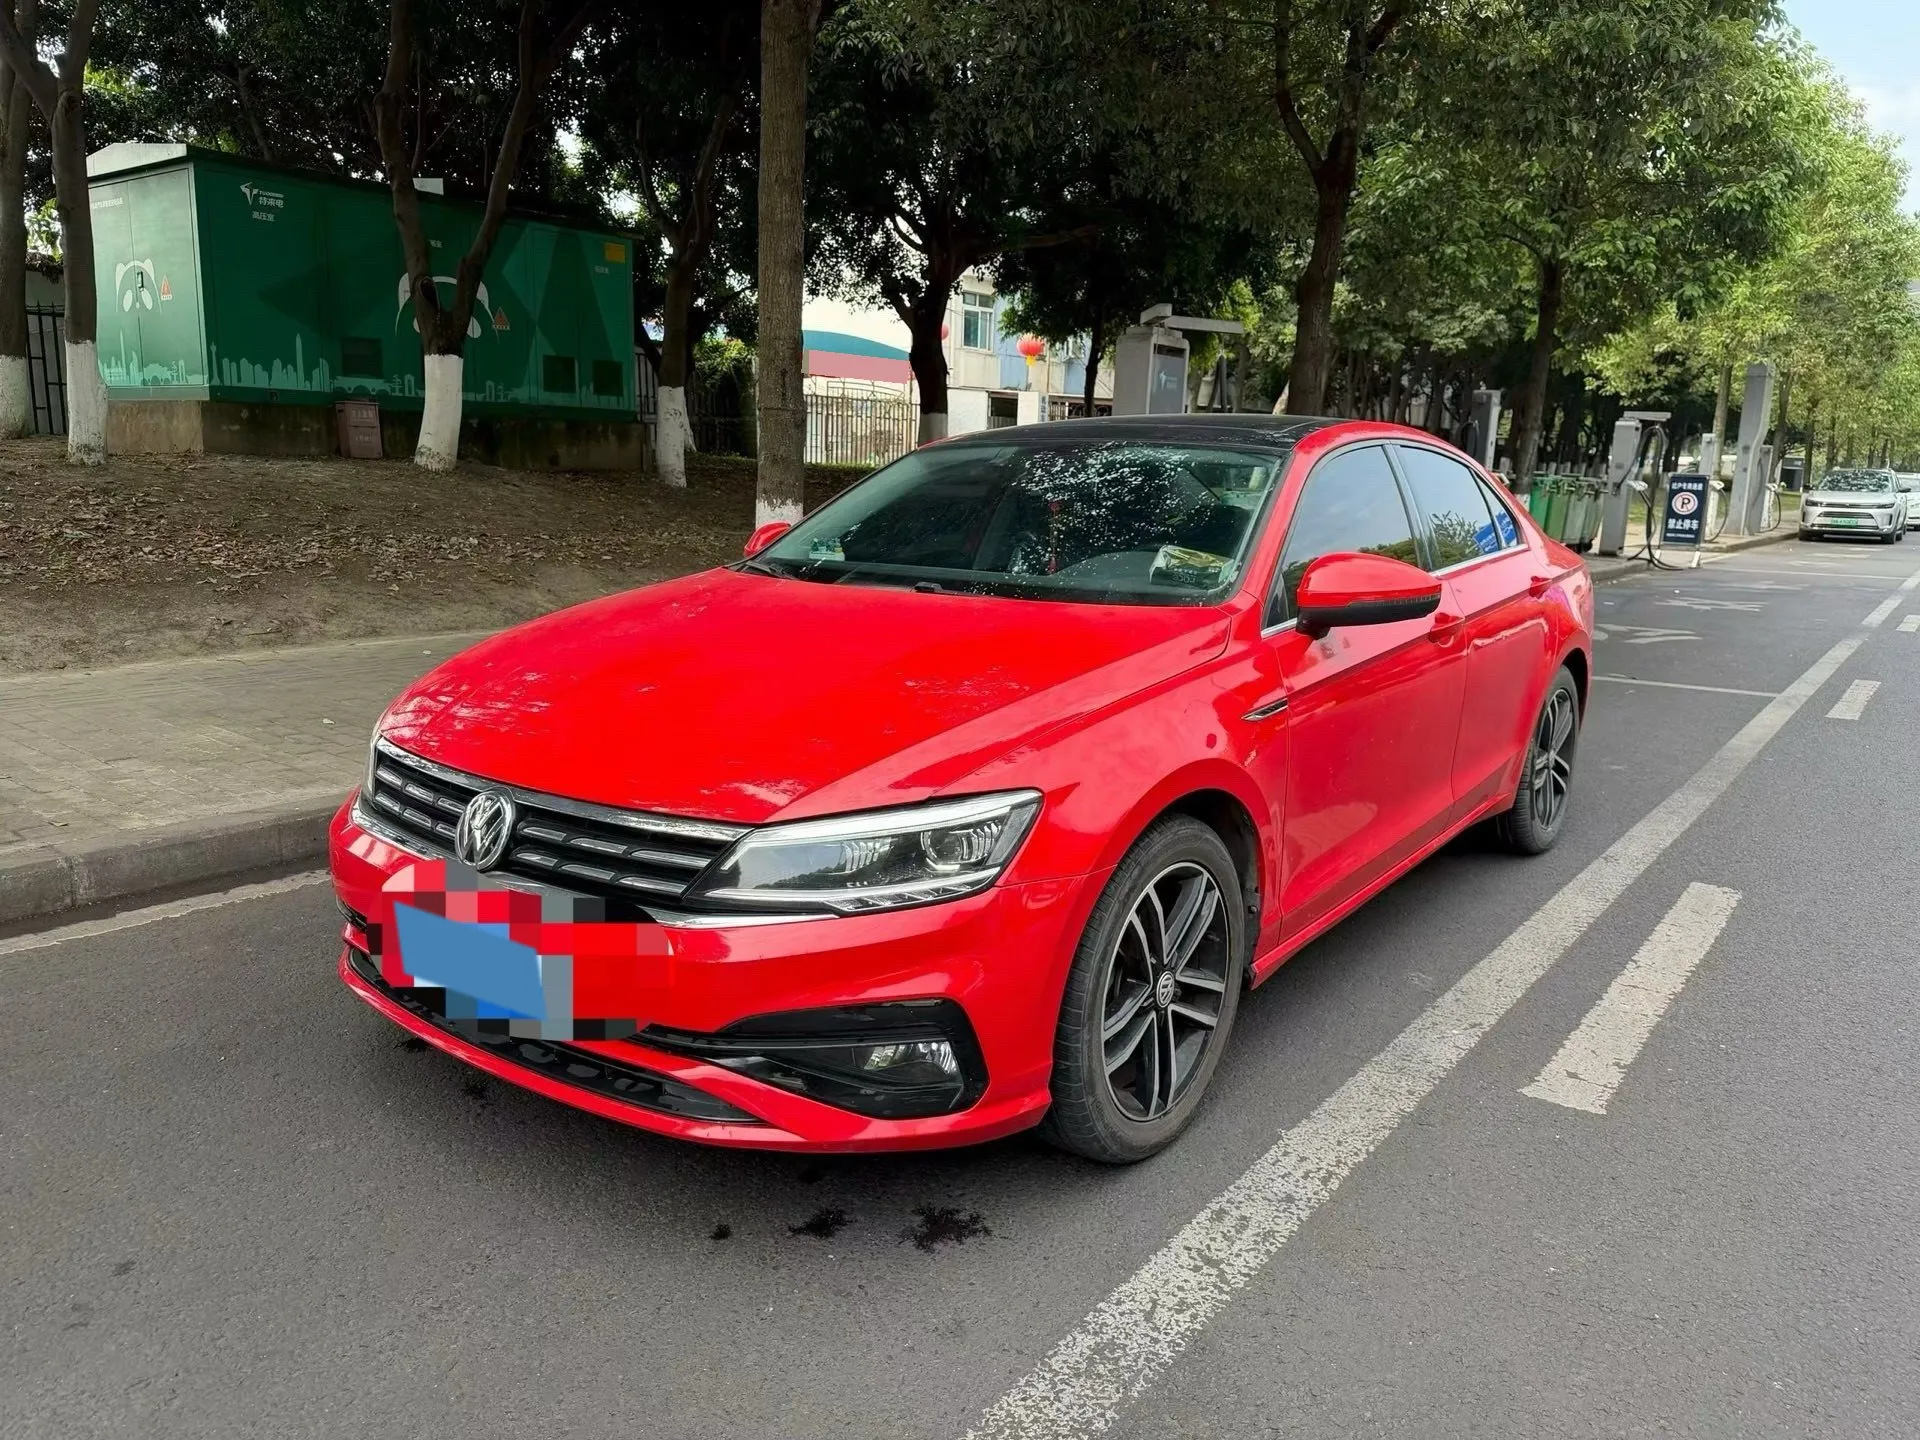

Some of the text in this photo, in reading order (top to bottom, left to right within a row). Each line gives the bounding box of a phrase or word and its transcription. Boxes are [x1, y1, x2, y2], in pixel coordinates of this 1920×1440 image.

[258, 196, 284, 208] 特来电
[1667, 518, 1700, 531] 禁止停车
